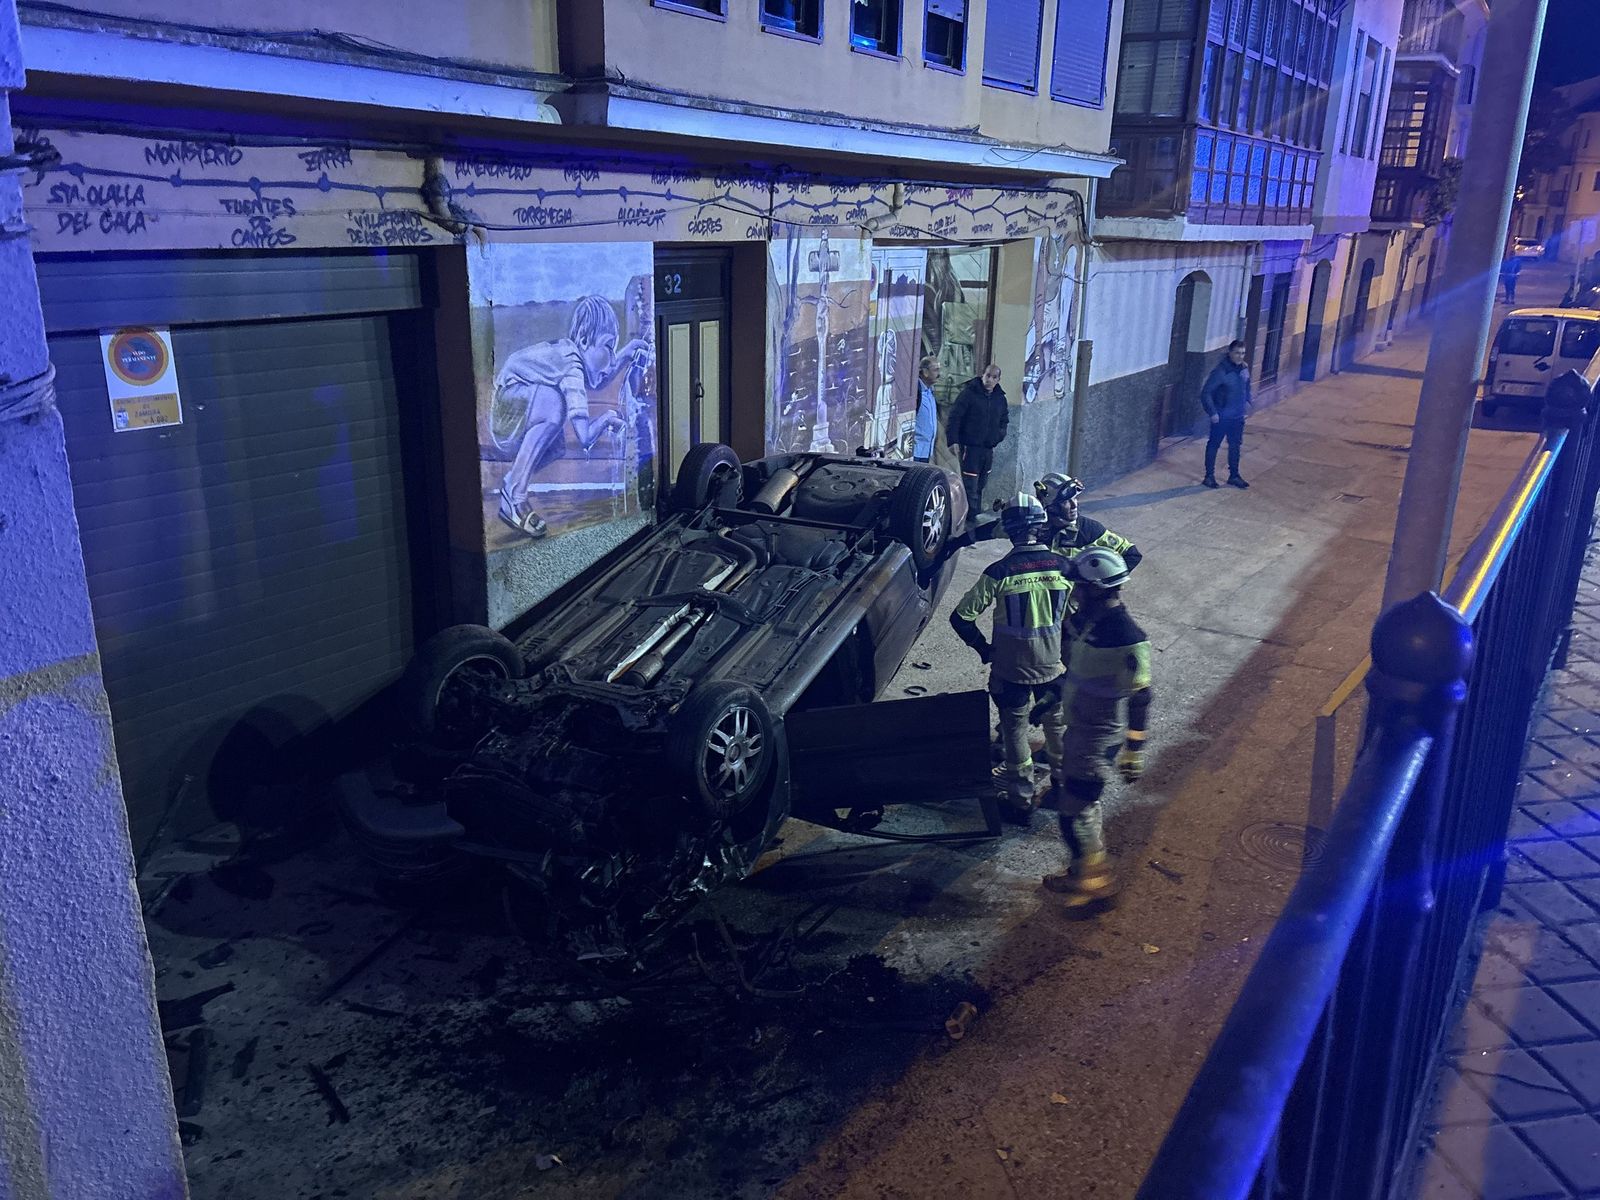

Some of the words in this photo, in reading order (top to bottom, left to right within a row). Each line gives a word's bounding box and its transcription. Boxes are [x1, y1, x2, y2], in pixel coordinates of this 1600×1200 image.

[87, 184, 146, 207] OLALLA
[219, 198, 297, 217] FUENTES
[57, 211, 92, 236] DEL
[231, 228, 297, 249] CANTOS
[664, 273, 682, 295] 32
[1033, 575, 1061, 583] ZAMORA
